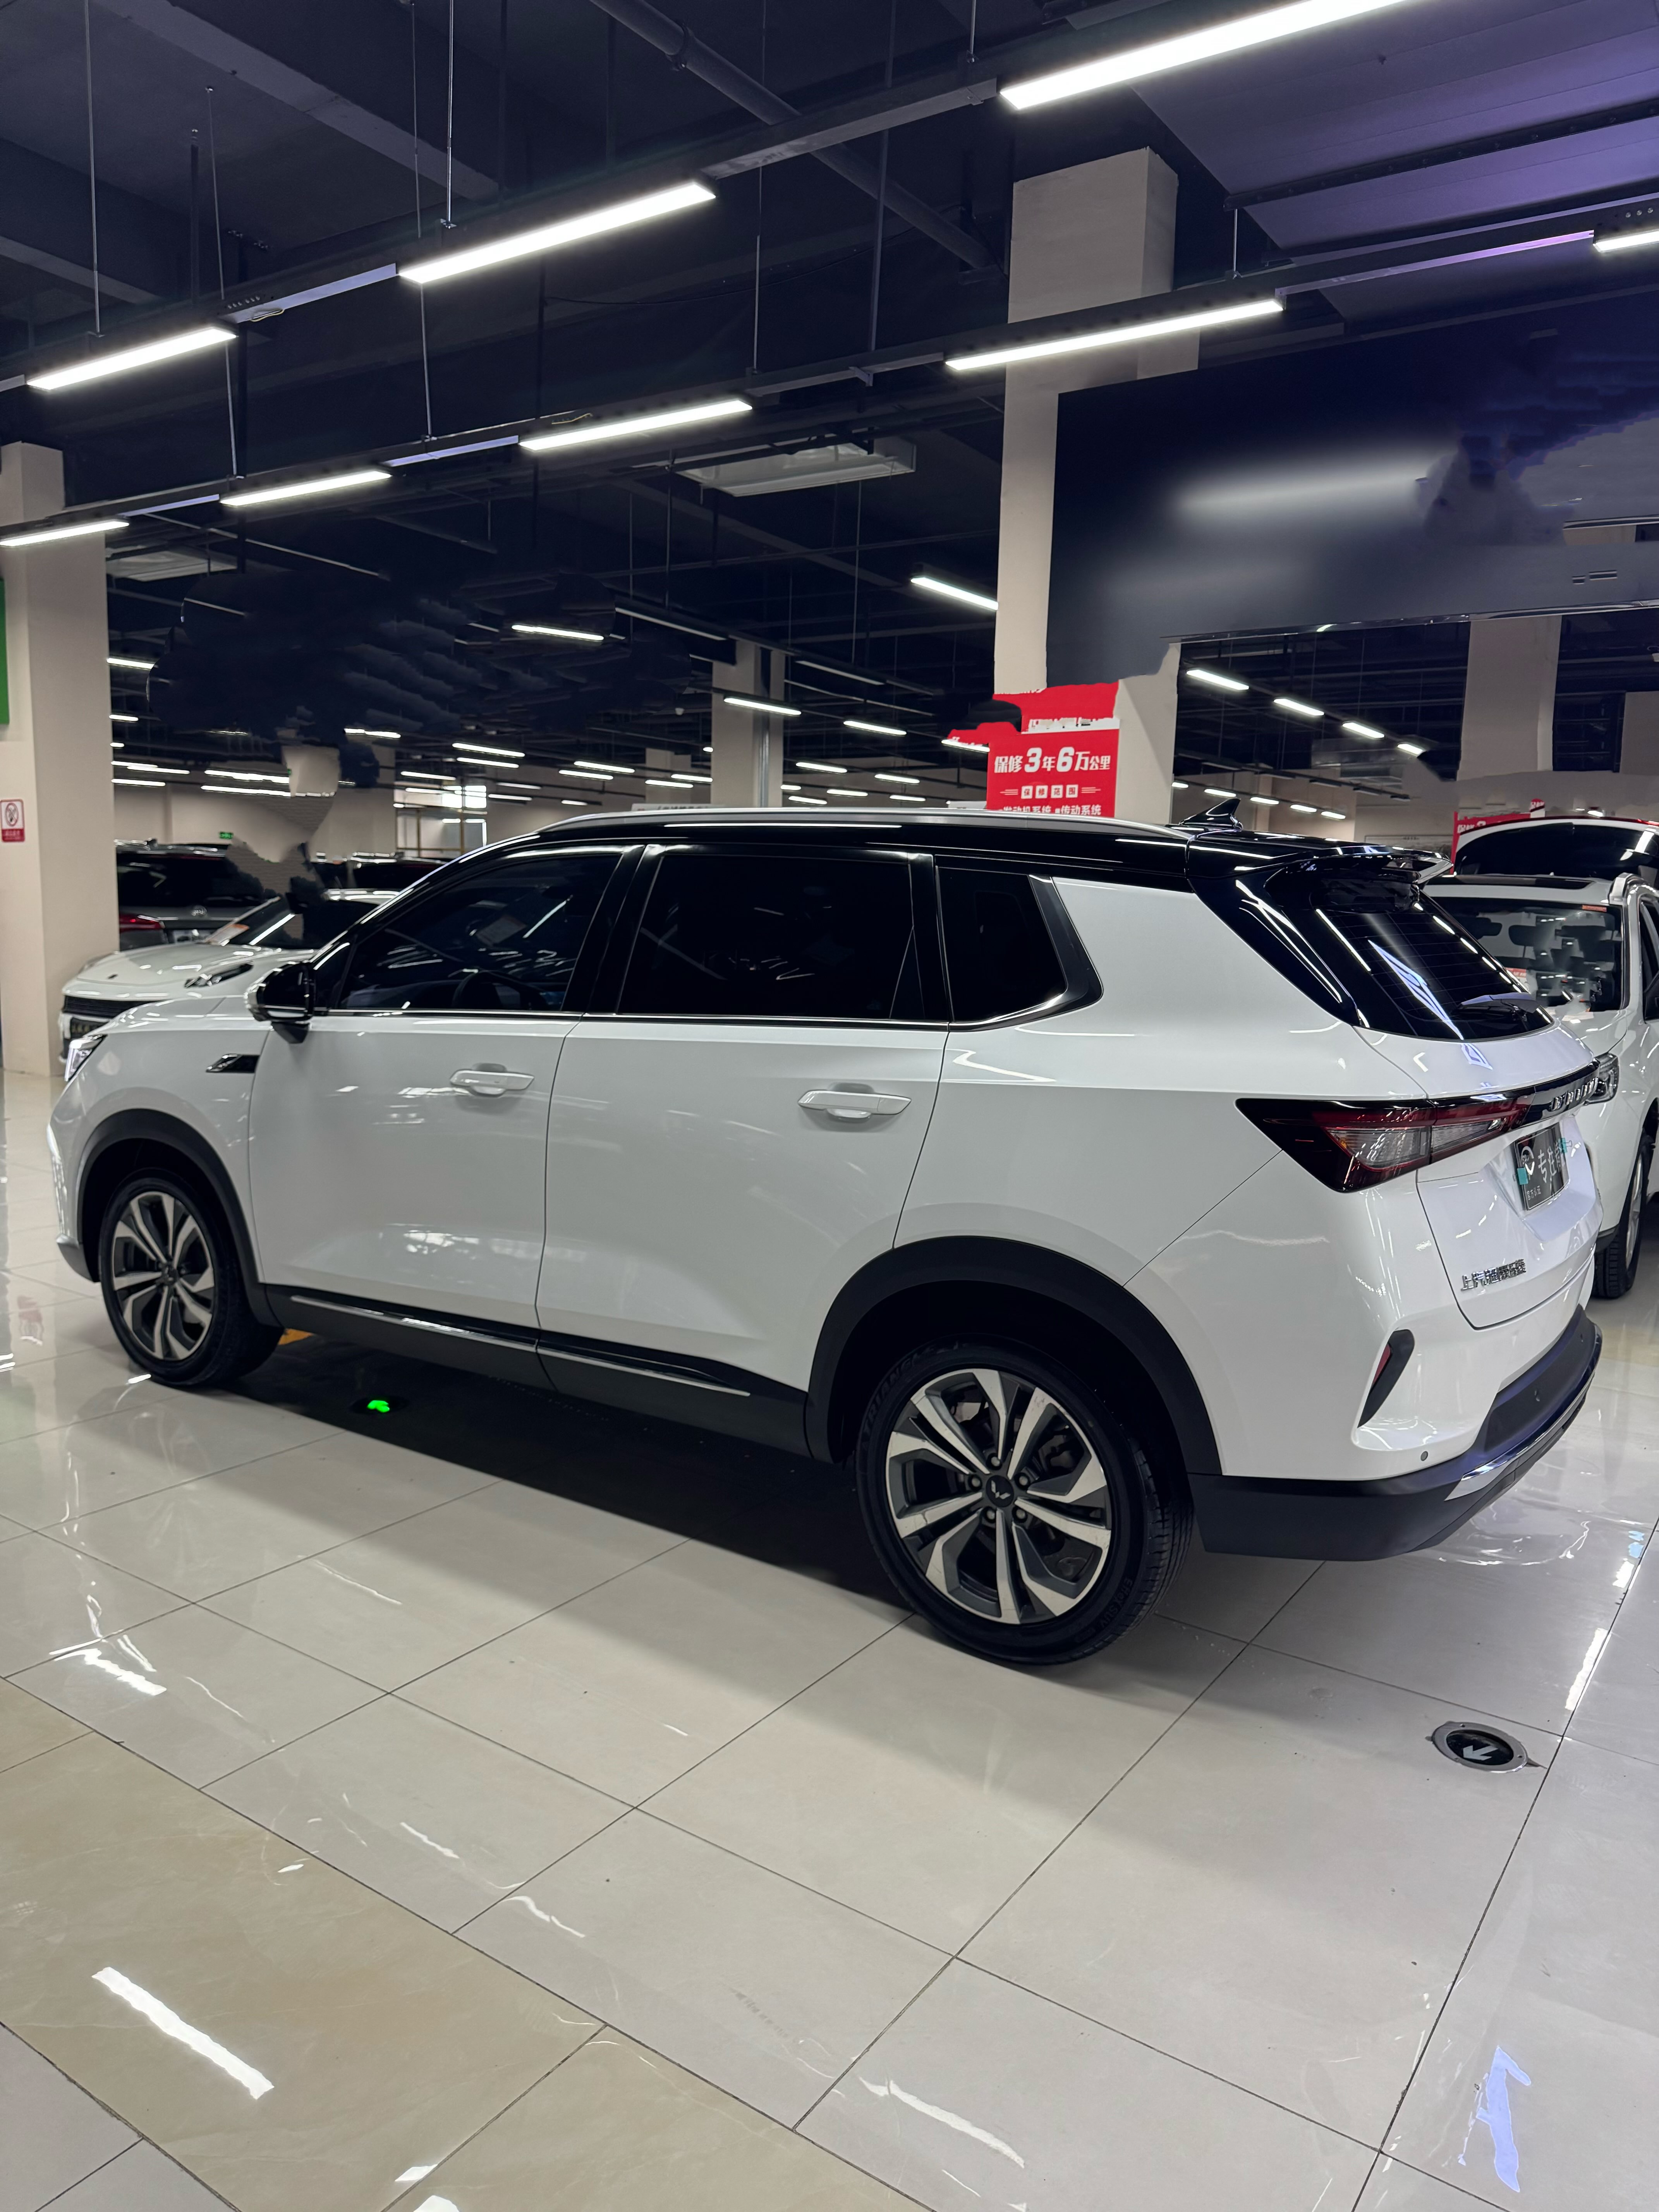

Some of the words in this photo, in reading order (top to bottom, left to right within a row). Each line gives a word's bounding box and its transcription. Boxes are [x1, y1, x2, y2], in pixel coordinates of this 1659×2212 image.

[994, 747, 1111, 773] 保修3年6万公里
[1061, 804, 1101, 816] 传动系统
